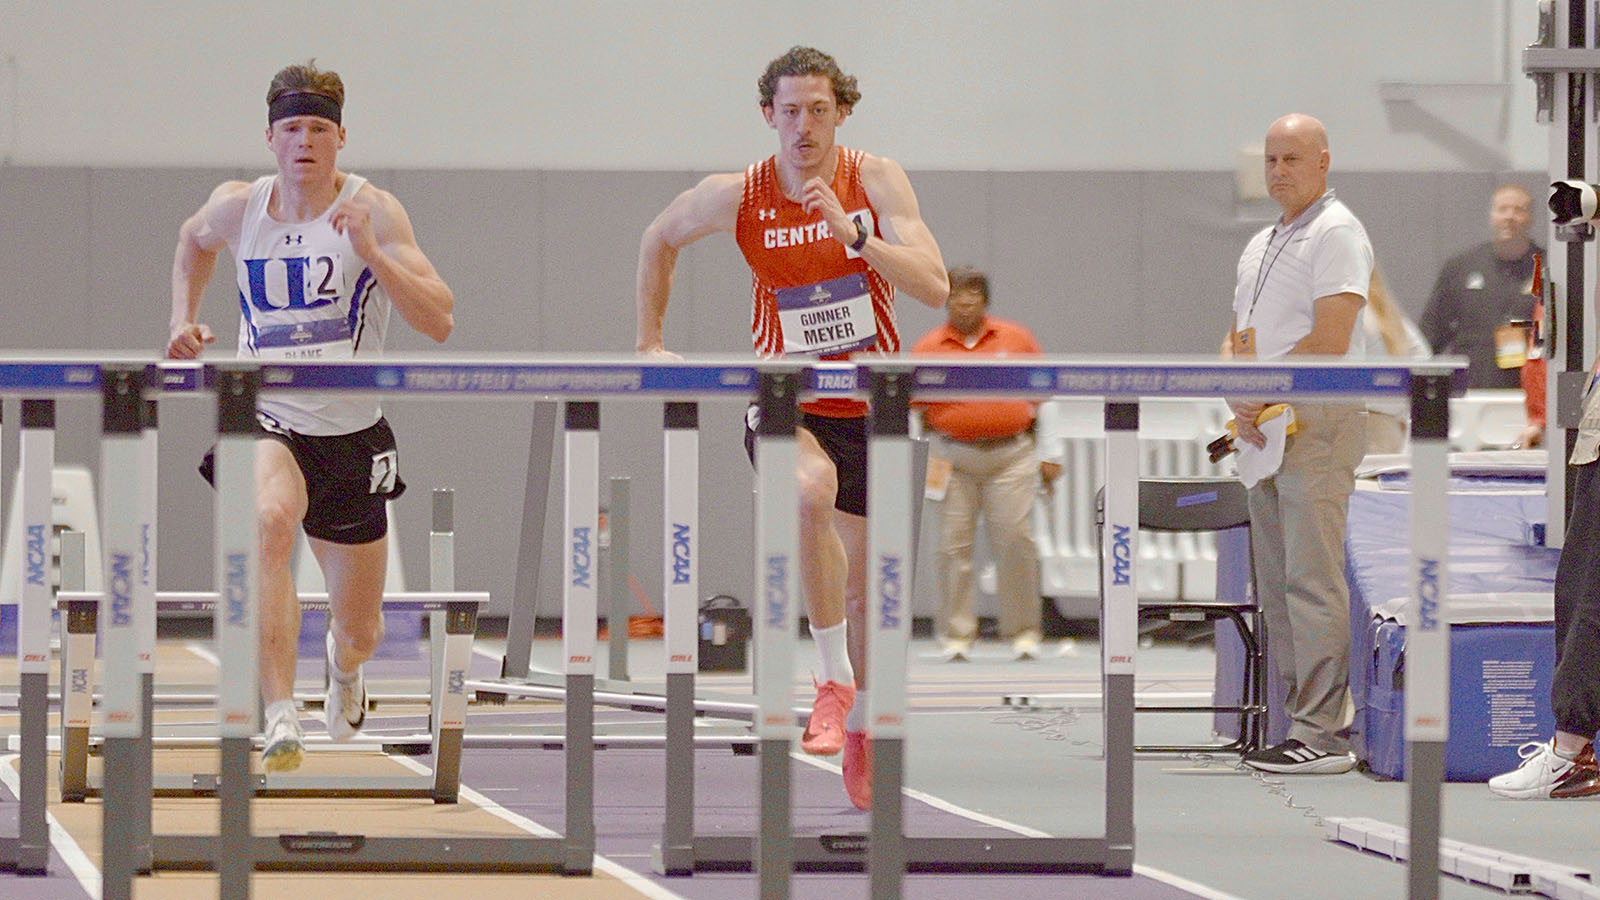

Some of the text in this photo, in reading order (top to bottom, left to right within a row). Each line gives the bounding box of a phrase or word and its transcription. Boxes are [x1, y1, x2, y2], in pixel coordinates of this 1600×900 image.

[764, 220, 833, 249] CENTR
[316, 256, 337, 295] 2
[800, 306, 851, 326] GUNNER
[804, 322, 855, 346] MEYER
[405, 371, 453, 390] TRACK
[515, 371, 641, 391] CHAMPIONSHIPS
[1058, 373, 1107, 390] TRACK
[1165, 373, 1293, 391] CHAMPIONSHIPS
[376, 456, 391, 494] 2
[27, 524, 46, 587] NCAA
[572, 526, 591, 589] NCAA
[671, 523, 691, 585] NCAA
[1112, 524, 1131, 586] NCAA
